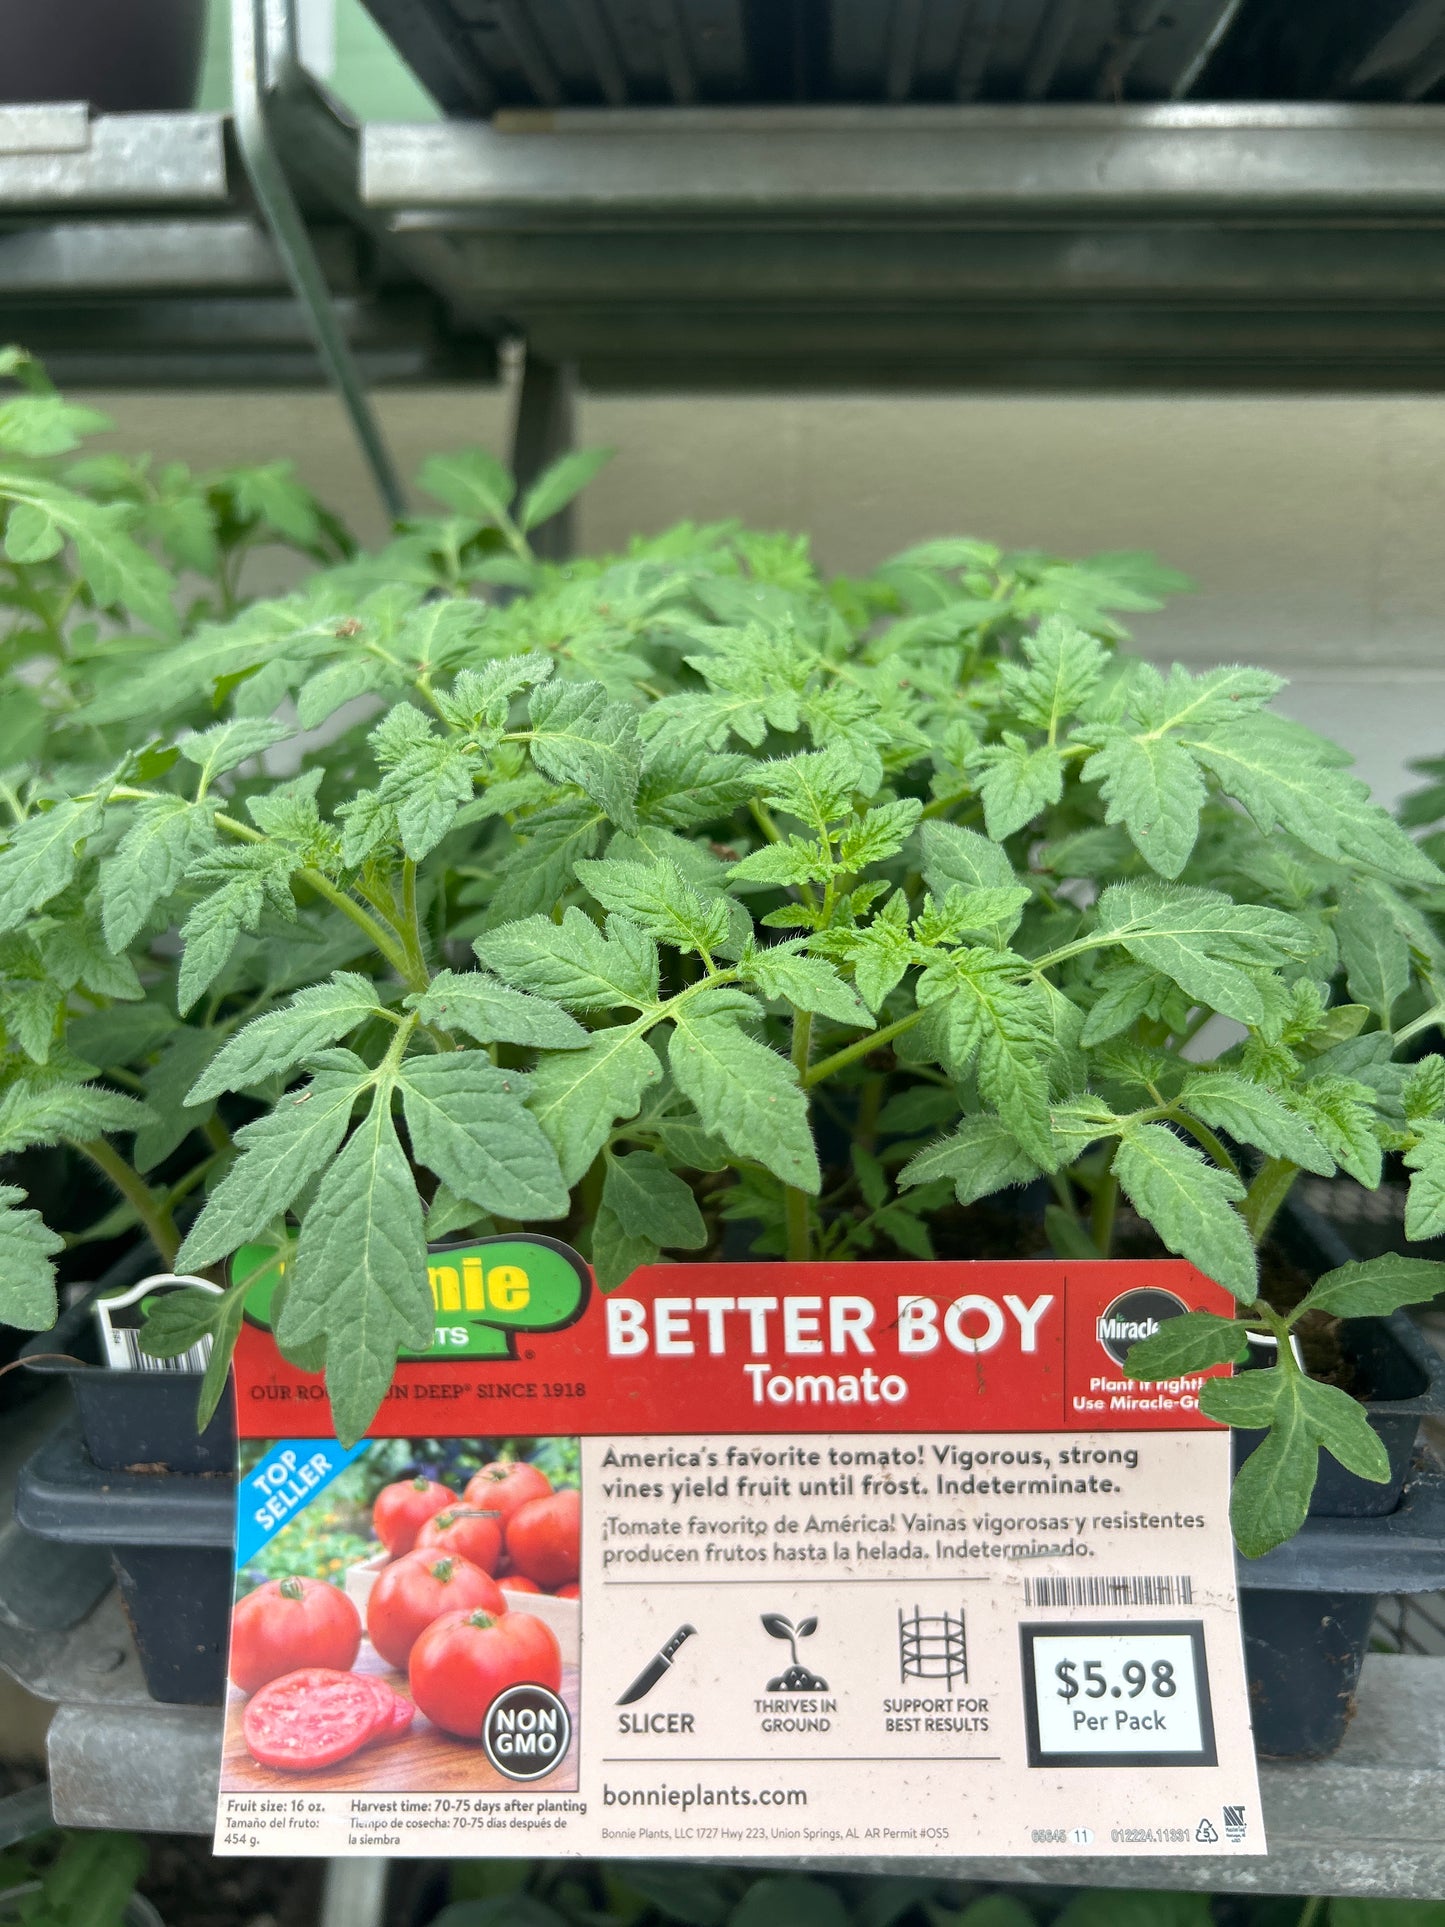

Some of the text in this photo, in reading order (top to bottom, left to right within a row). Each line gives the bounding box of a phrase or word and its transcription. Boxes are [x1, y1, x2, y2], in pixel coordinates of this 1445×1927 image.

[606, 1295, 1054, 1355] BETTER BOY
[250, 1385, 292, 1400] OUR
[477, 1383, 537, 1398] SINCE
[543, 1383, 586, 1398] 1918
[743, 1363, 907, 1403] Tomato
[1090, 1376, 1135, 1392] Plant
[1073, 1394, 1199, 1411] Use Miracle-Gr
[601, 1445, 1139, 1470] America's favorite tomato! Vigorous, strong
[252, 1449, 298, 1497] TOP
[254, 1453, 333, 1532] SELLER
[602, 1473, 1122, 1504] vines yield fruit until frost. Indeterminate.
[602, 1511, 1206, 1541] ¡Tomate favorito de América! Vainas vigorosas y resistentes
[602, 1539, 1095, 1568] producen frutos hasta la helada. Indeterminado.
[1055, 1657, 1177, 1705] $5.98
[754, 1698, 837, 1714] THRIVES IN
[882, 1698, 989, 1714] SUPPORT FOR
[496, 1708, 557, 1732] NON
[618, 1713, 696, 1734] SLICER
[761, 1717, 832, 1733] GROUND
[885, 1717, 989, 1732] BEST RESULTS
[1073, 1709, 1167, 1731] Per Pack
[496, 1732, 557, 1755] GMO
[227, 1800, 326, 1812] Fruit size: 16 oz.
[602, 1783, 808, 1812] bonnieplants.com
[351, 1799, 588, 1815] Harvest time: 70-75 days after planting
[226, 1817, 320, 1829] Tamaño del fruto:
[391, 1817, 404, 1829] de
[406, 1817, 450, 1828] cosecha:
[453, 1817, 484, 1828] 70-75
[487, 1817, 507, 1828] días
[510, 1817, 552, 1831] después
[554, 1816, 568, 1828] de
[224, 1834, 260, 1847] 454 g.
[348, 1834, 401, 1845] la siembra
[601, 1827, 636, 1839] Bonnie
[639, 1827, 672, 1841] Plants,
[675, 1827, 694, 1839] LLC
[696, 1827, 719, 1839] 1727
[721, 1827, 743, 1842] Hwy
[746, 1827, 768, 1841] 223,
[771, 1827, 801, 1839] Union
[803, 1827, 844, 1842] Springs,
[845, 1827, 860, 1839] AL
[865, 1827, 881, 1839] AR
[883, 1827, 918, 1839] Permit
[1074, 1829, 1088, 1843] 11
